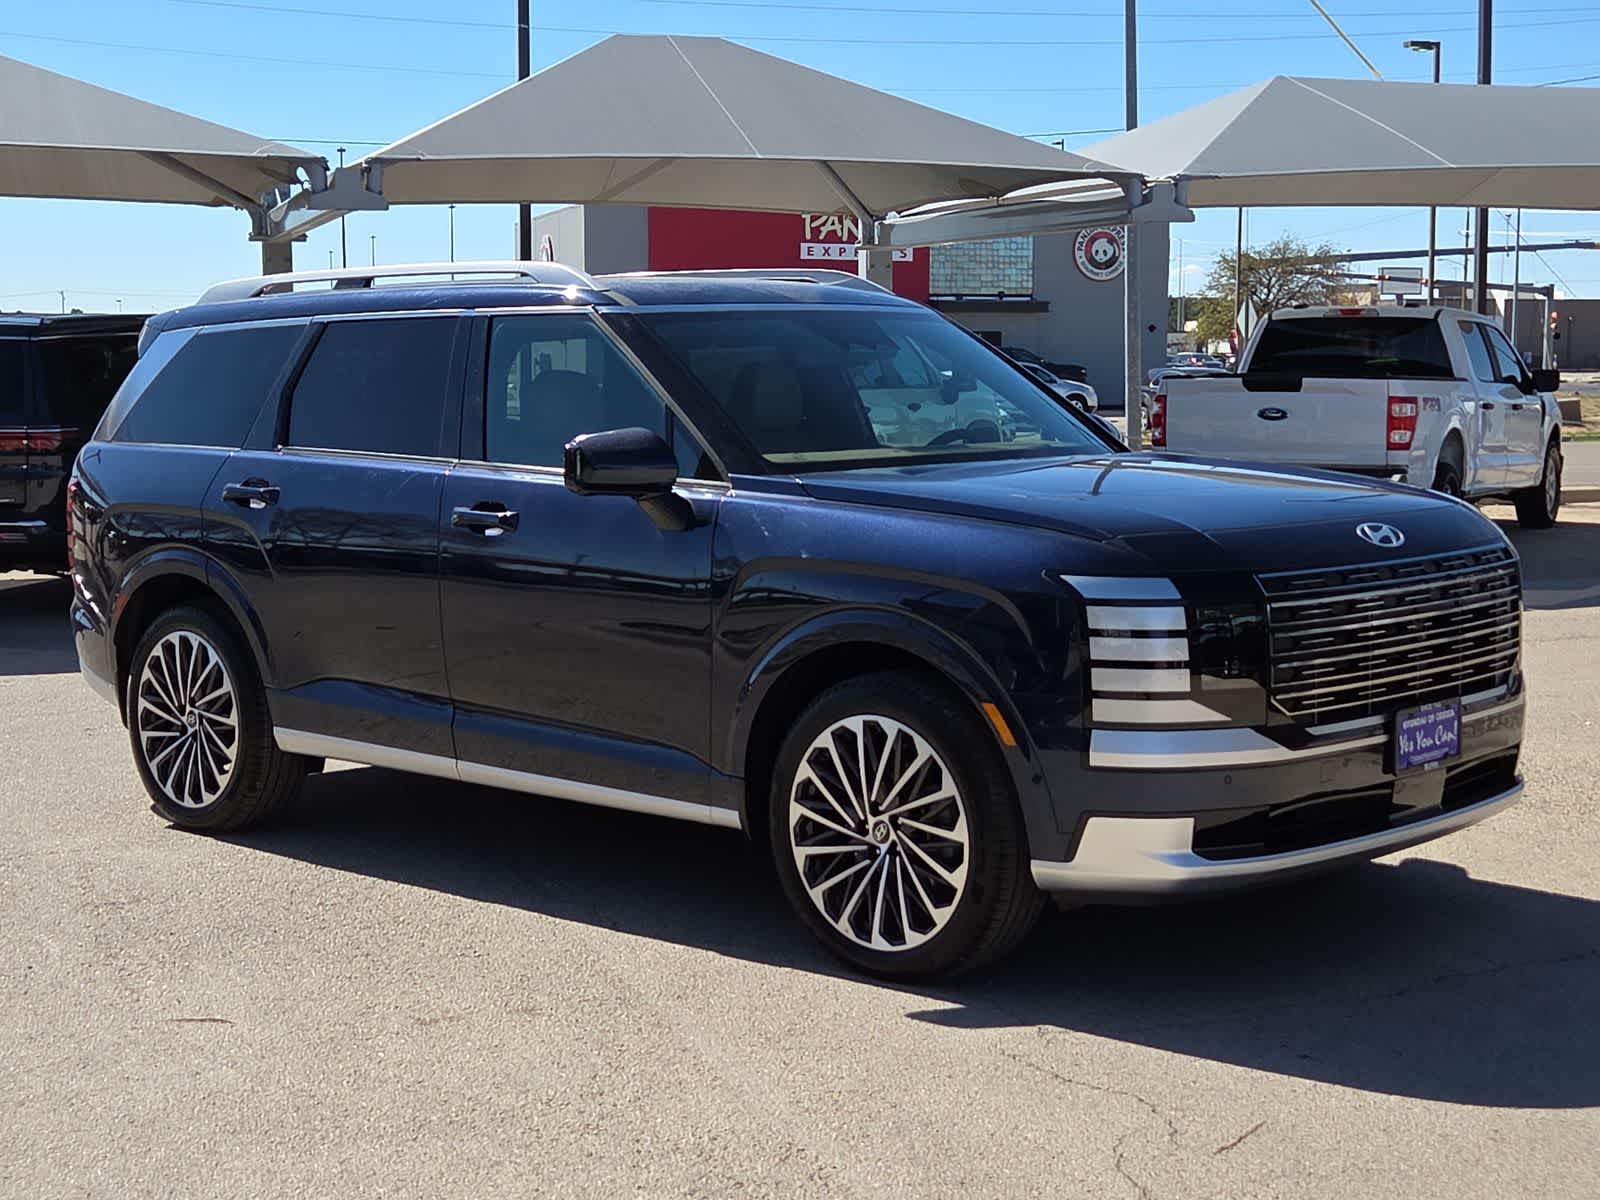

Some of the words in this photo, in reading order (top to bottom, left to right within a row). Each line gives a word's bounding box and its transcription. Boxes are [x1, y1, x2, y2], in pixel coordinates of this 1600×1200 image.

[802, 214, 859, 241] PAN
[806, 246, 907, 259] EXPS
[1399, 734, 1414, 755] Yes
[1416, 728, 1434, 751] You
